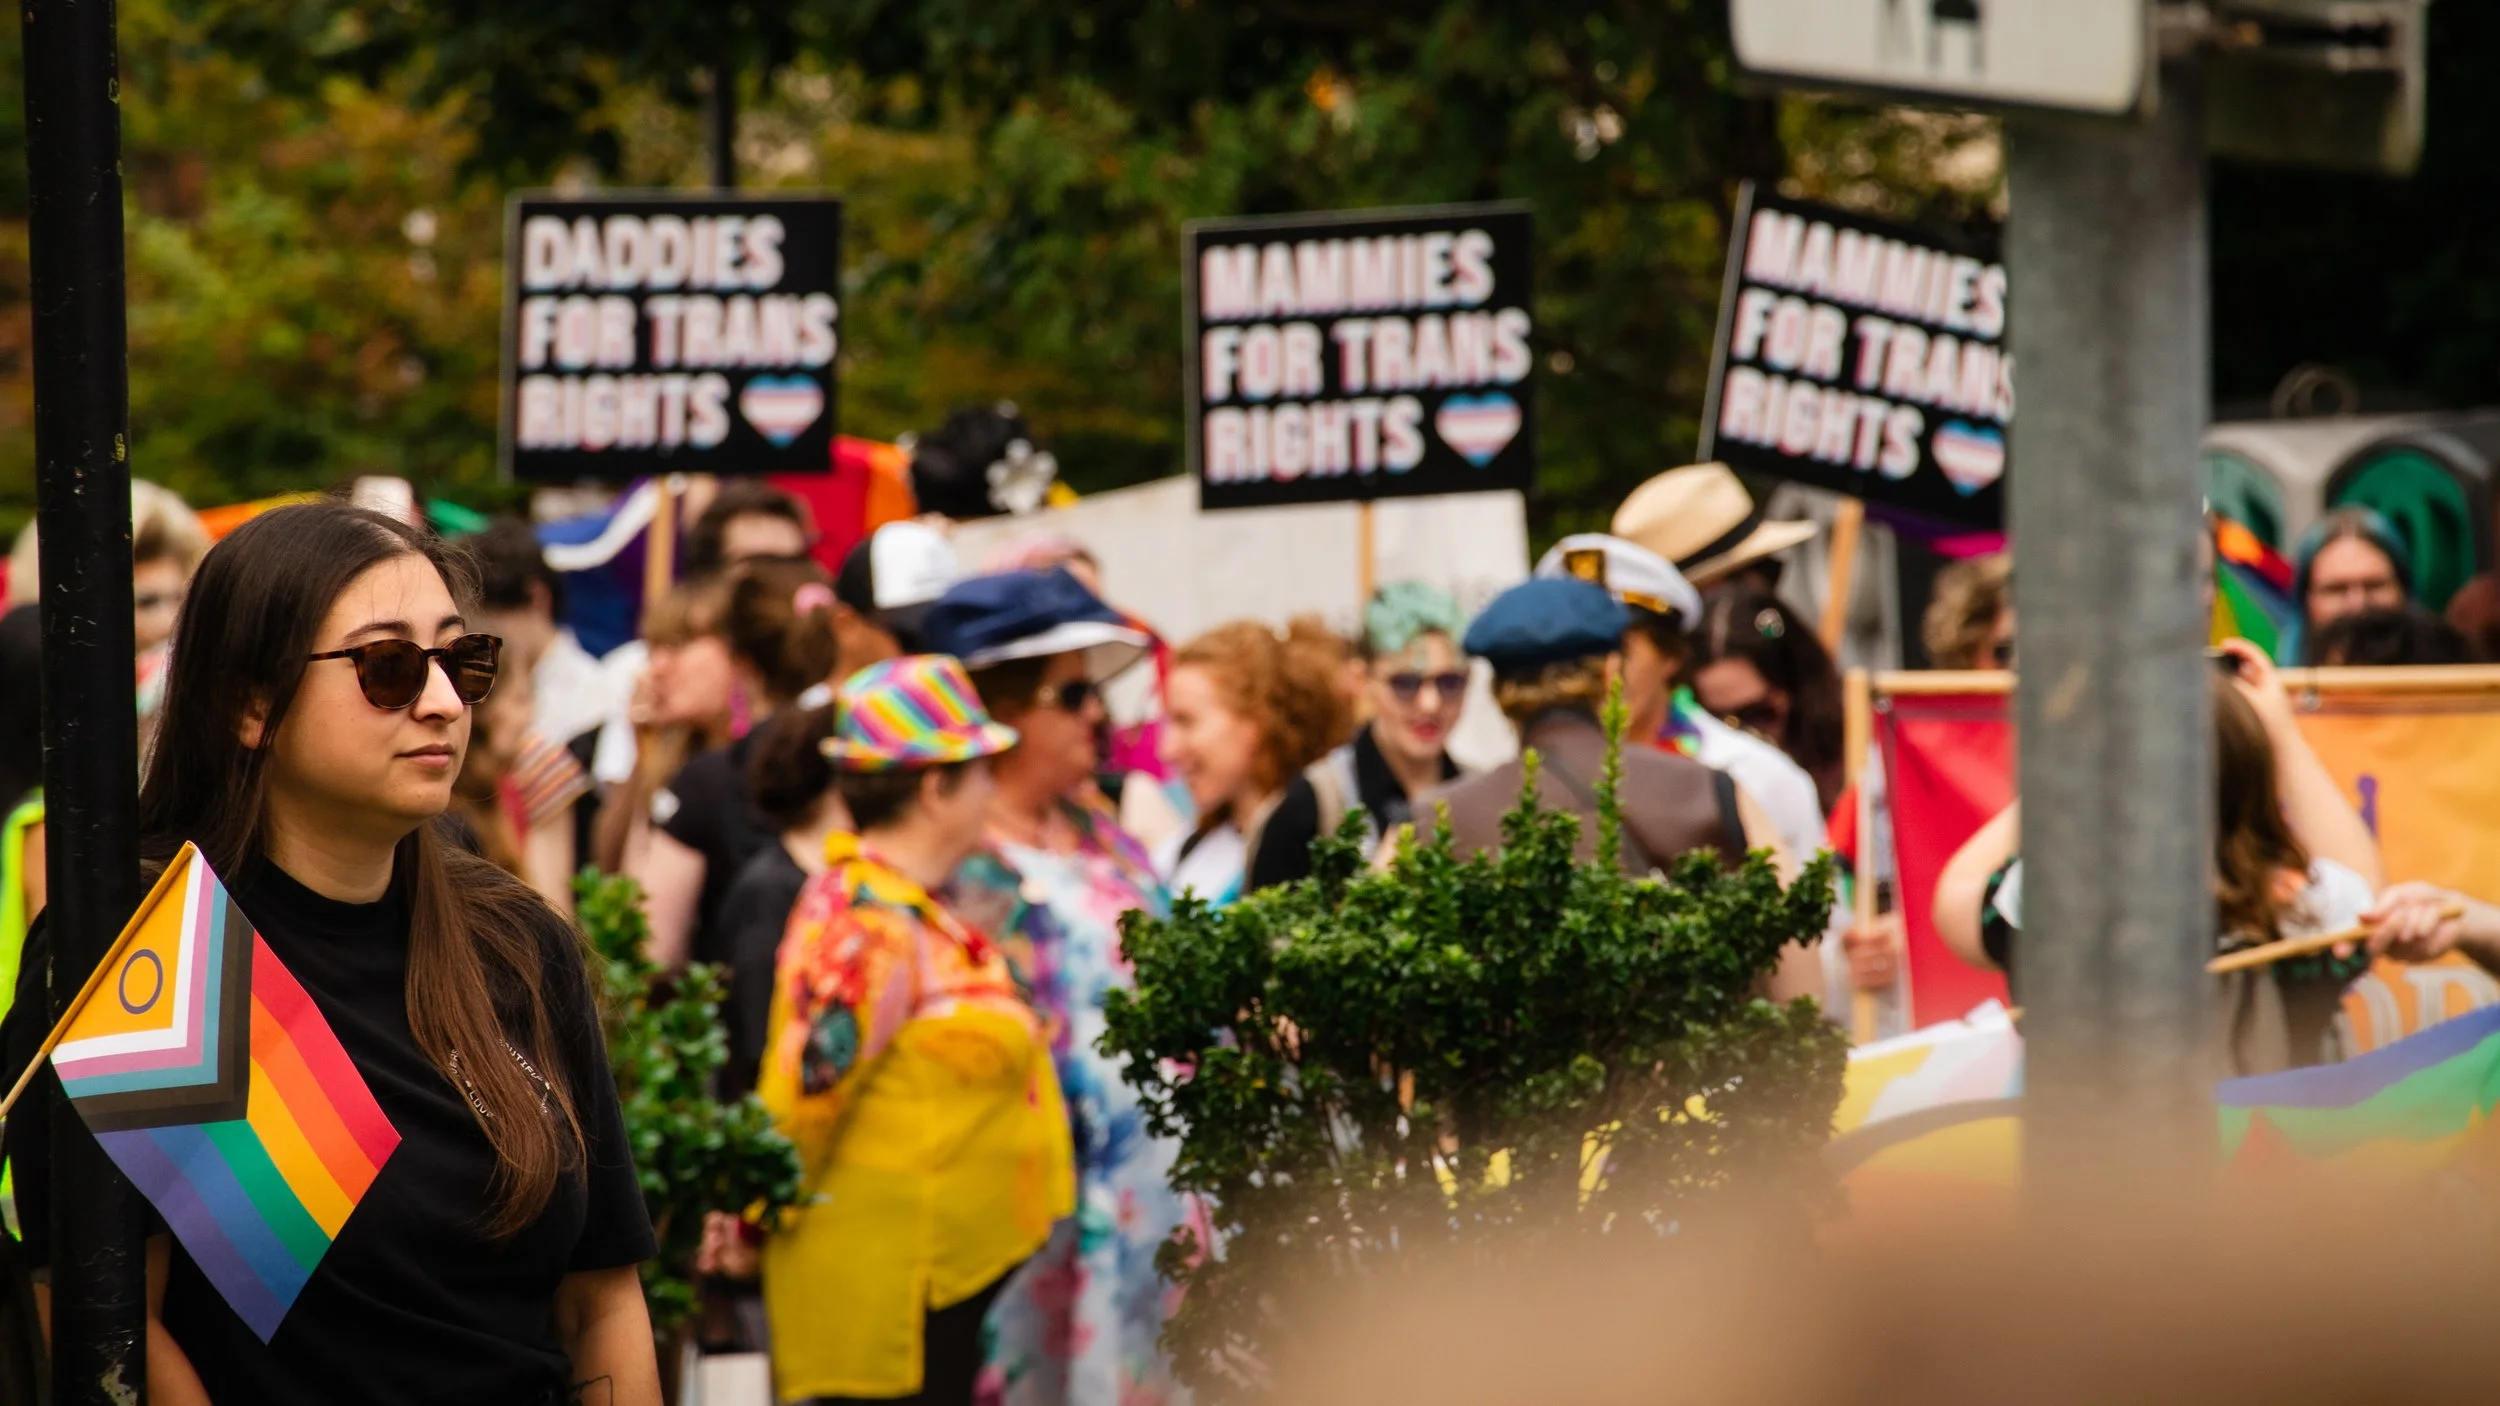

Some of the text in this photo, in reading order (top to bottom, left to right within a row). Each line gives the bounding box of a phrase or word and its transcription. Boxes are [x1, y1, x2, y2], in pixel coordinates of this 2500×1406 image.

[523, 214, 785, 291] DADDIES
[1202, 228, 1495, 320] MAMMIES
[1744, 208, 2007, 340] MAMMIES
[521, 292, 839, 371] FOR TRANS
[1203, 306, 1532, 403] FOR TRANS
[1731, 286, 1848, 382] FOR
[518, 372, 731, 452] RIGHTS
[1204, 394, 1425, 485] RIGHTS
[1719, 365, 1925, 481] RIGHTS
